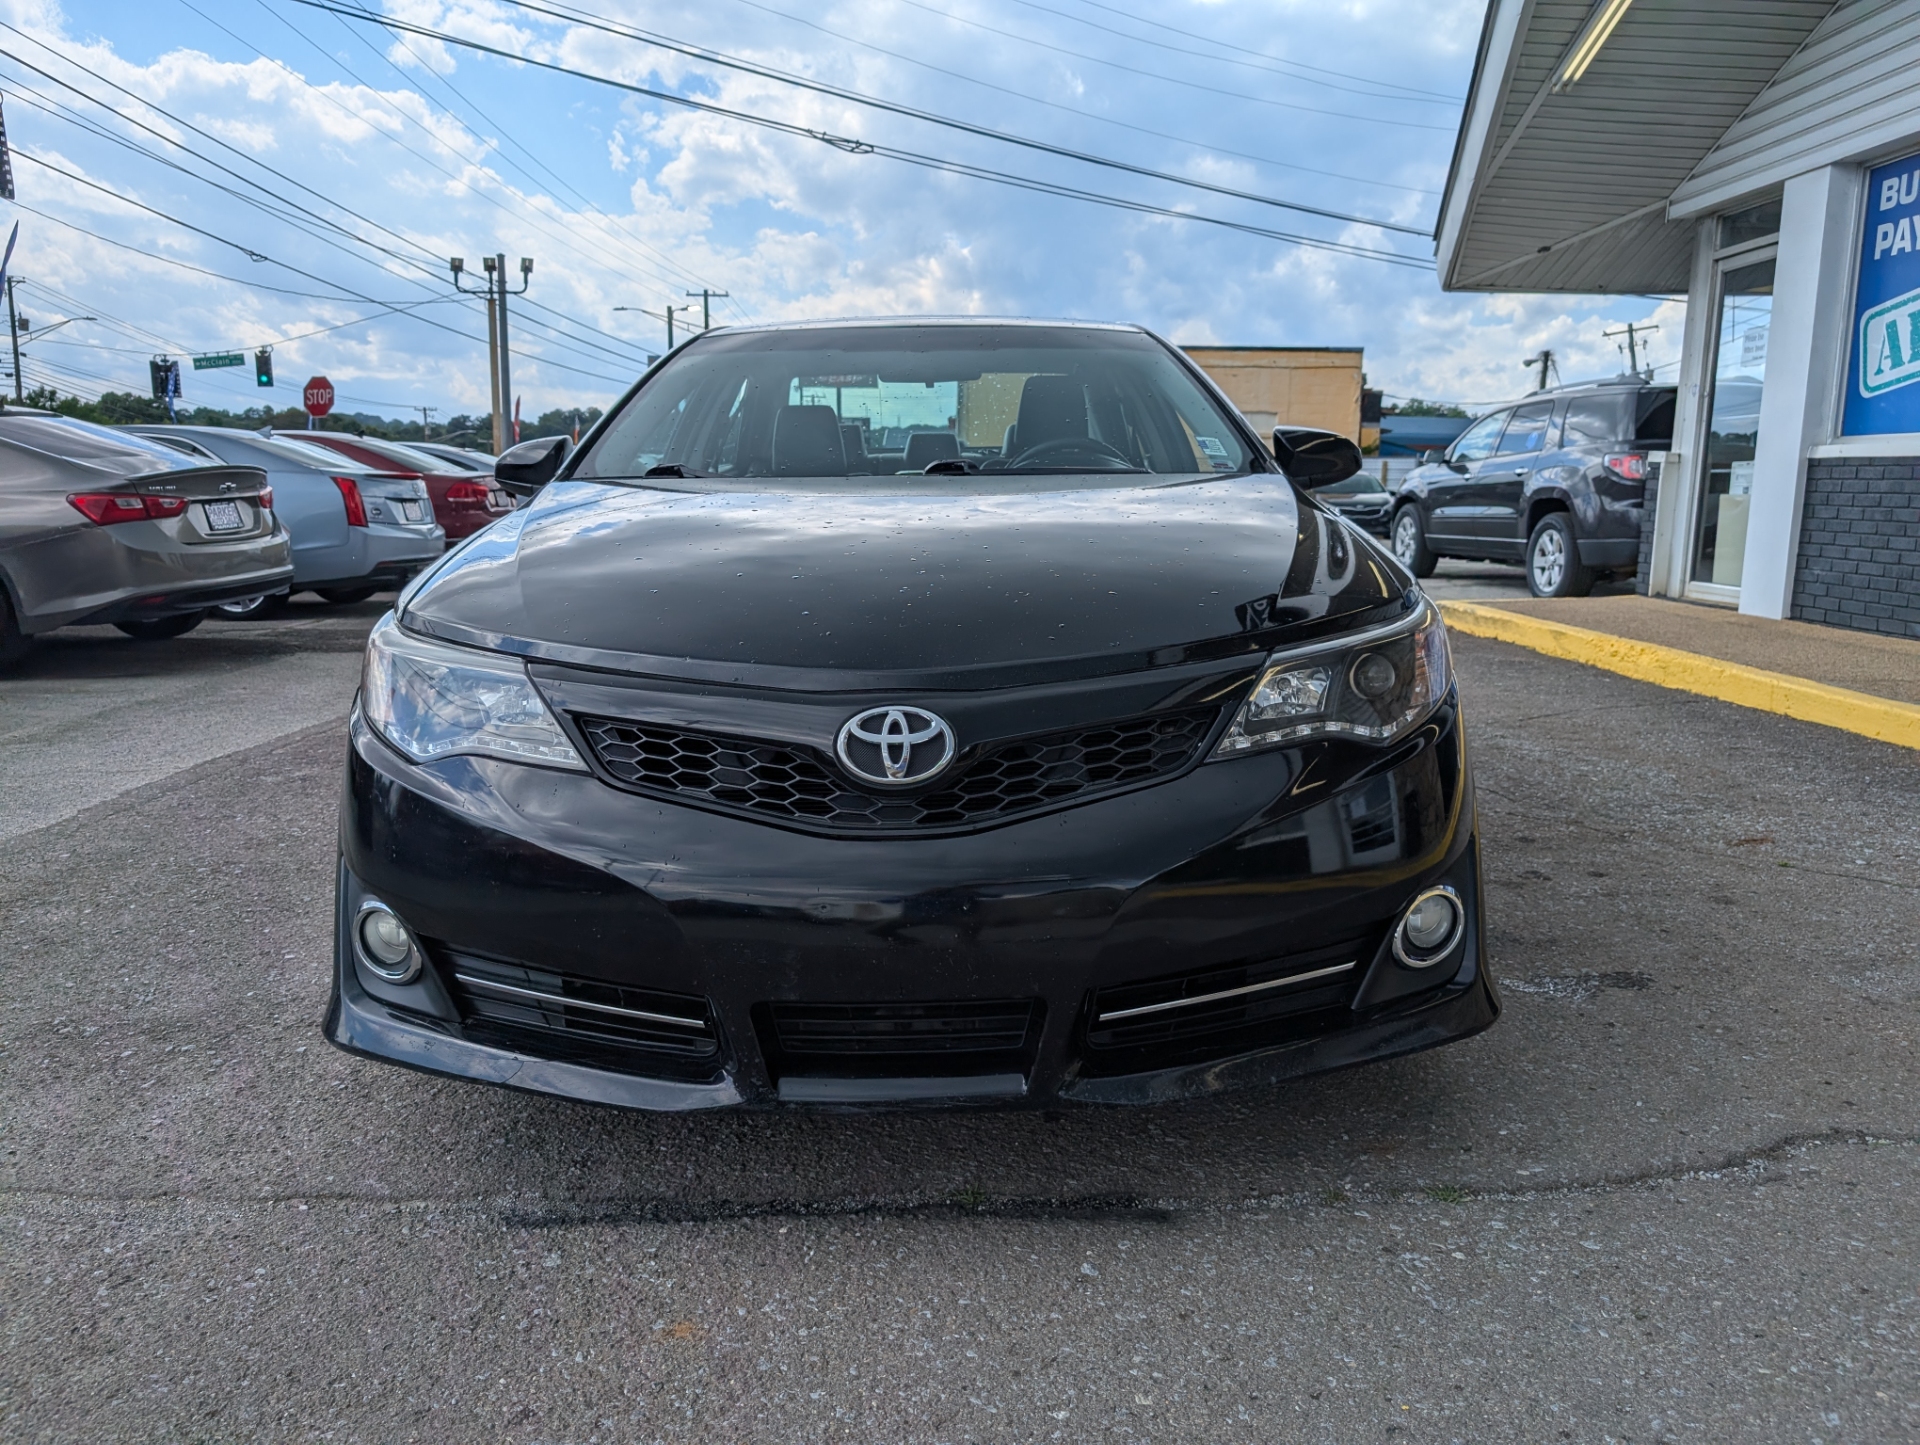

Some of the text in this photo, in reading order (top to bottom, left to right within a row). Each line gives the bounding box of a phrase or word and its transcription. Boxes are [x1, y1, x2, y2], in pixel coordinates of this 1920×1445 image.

[200, 358, 230, 367] McClain
[306, 389, 333, 405] STOP
[207, 504, 239, 518] PARKER
